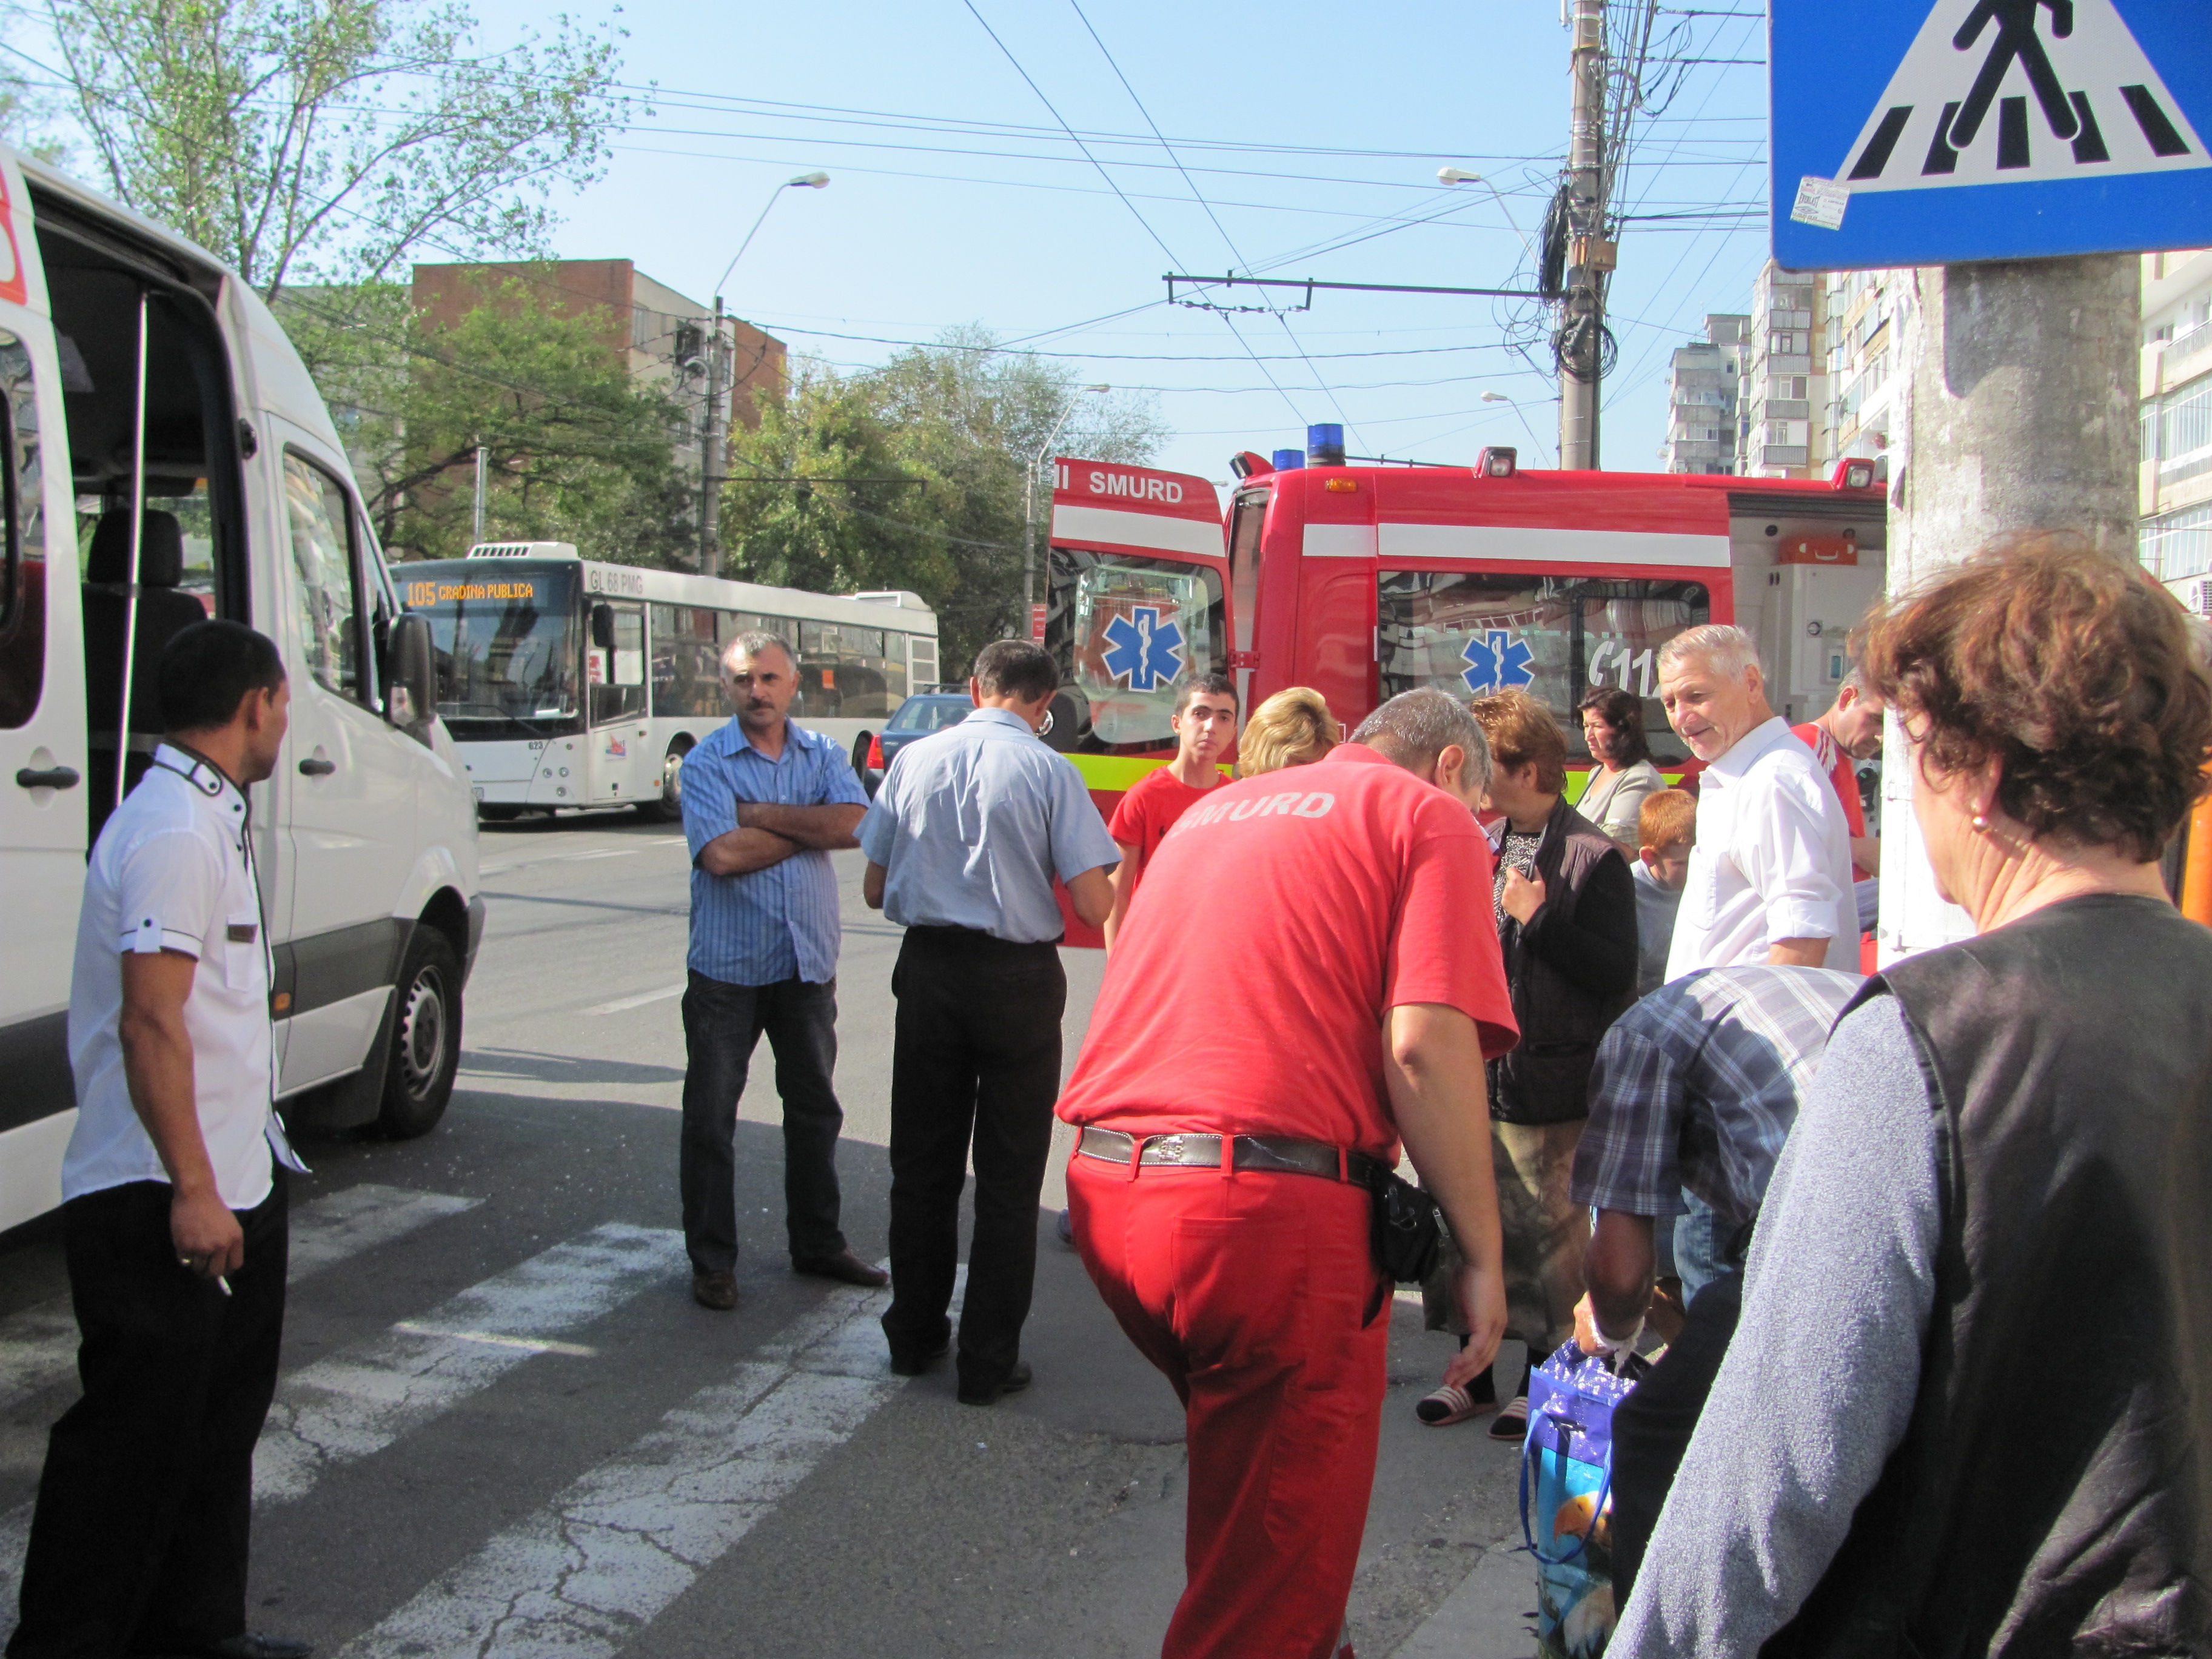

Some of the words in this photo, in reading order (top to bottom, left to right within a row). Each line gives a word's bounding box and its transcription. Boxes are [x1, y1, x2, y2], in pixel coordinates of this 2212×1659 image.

[1090, 471, 1182, 503] SMURD
[407, 581, 437, 606] 105
[438, 584, 485, 600] GRADINA
[488, 583, 533, 598] PUBLICA
[591, 570, 605, 591] GL
[607, 574, 619, 592] 68
[1611, 648, 1661, 697] 11
[529, 741, 543, 750] 623
